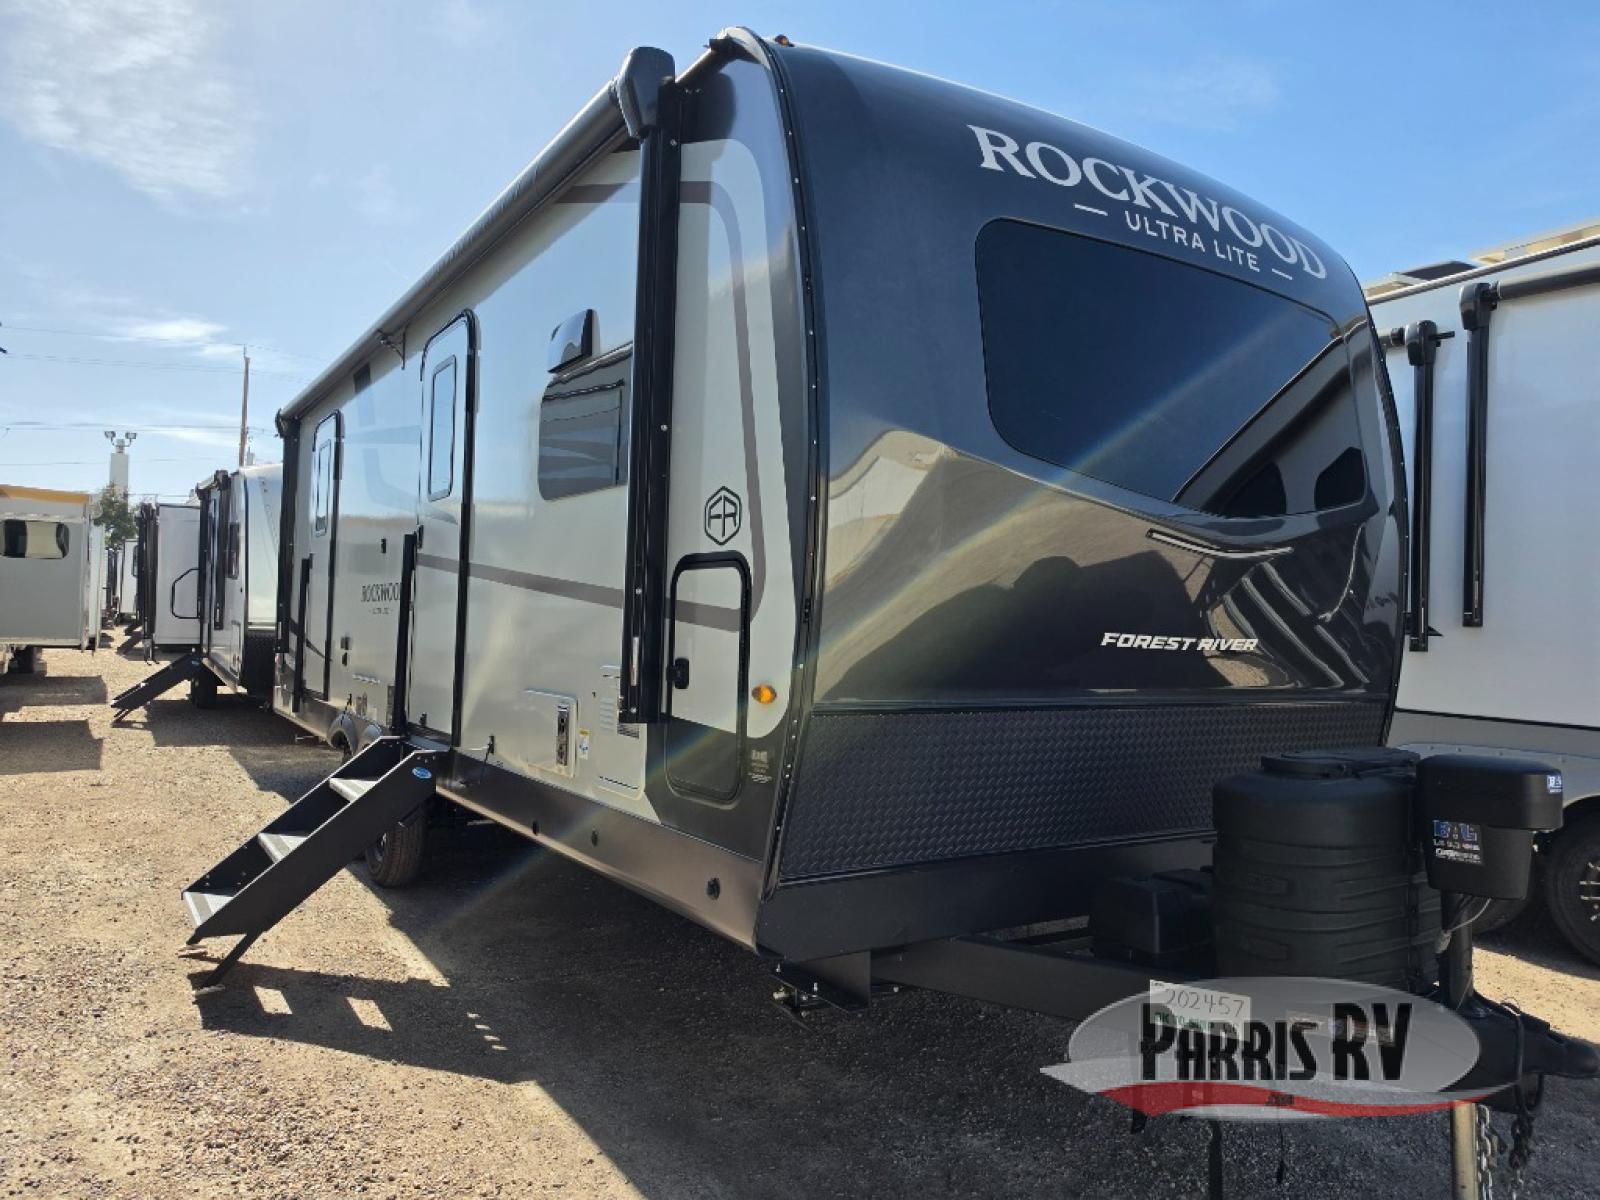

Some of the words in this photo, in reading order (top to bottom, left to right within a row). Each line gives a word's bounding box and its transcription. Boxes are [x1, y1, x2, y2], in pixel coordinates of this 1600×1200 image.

[967, 124, 1327, 280] ROCKWOOD
[1124, 210, 1205, 252] ULTRA
[1213, 242, 1260, 272] LITE
[361, 582, 402, 602] ROCKWOO
[1100, 632, 1197, 650] FOREST
[1197, 638, 1259, 651] RIVER
[1165, 988, 1245, 1018] 202457
